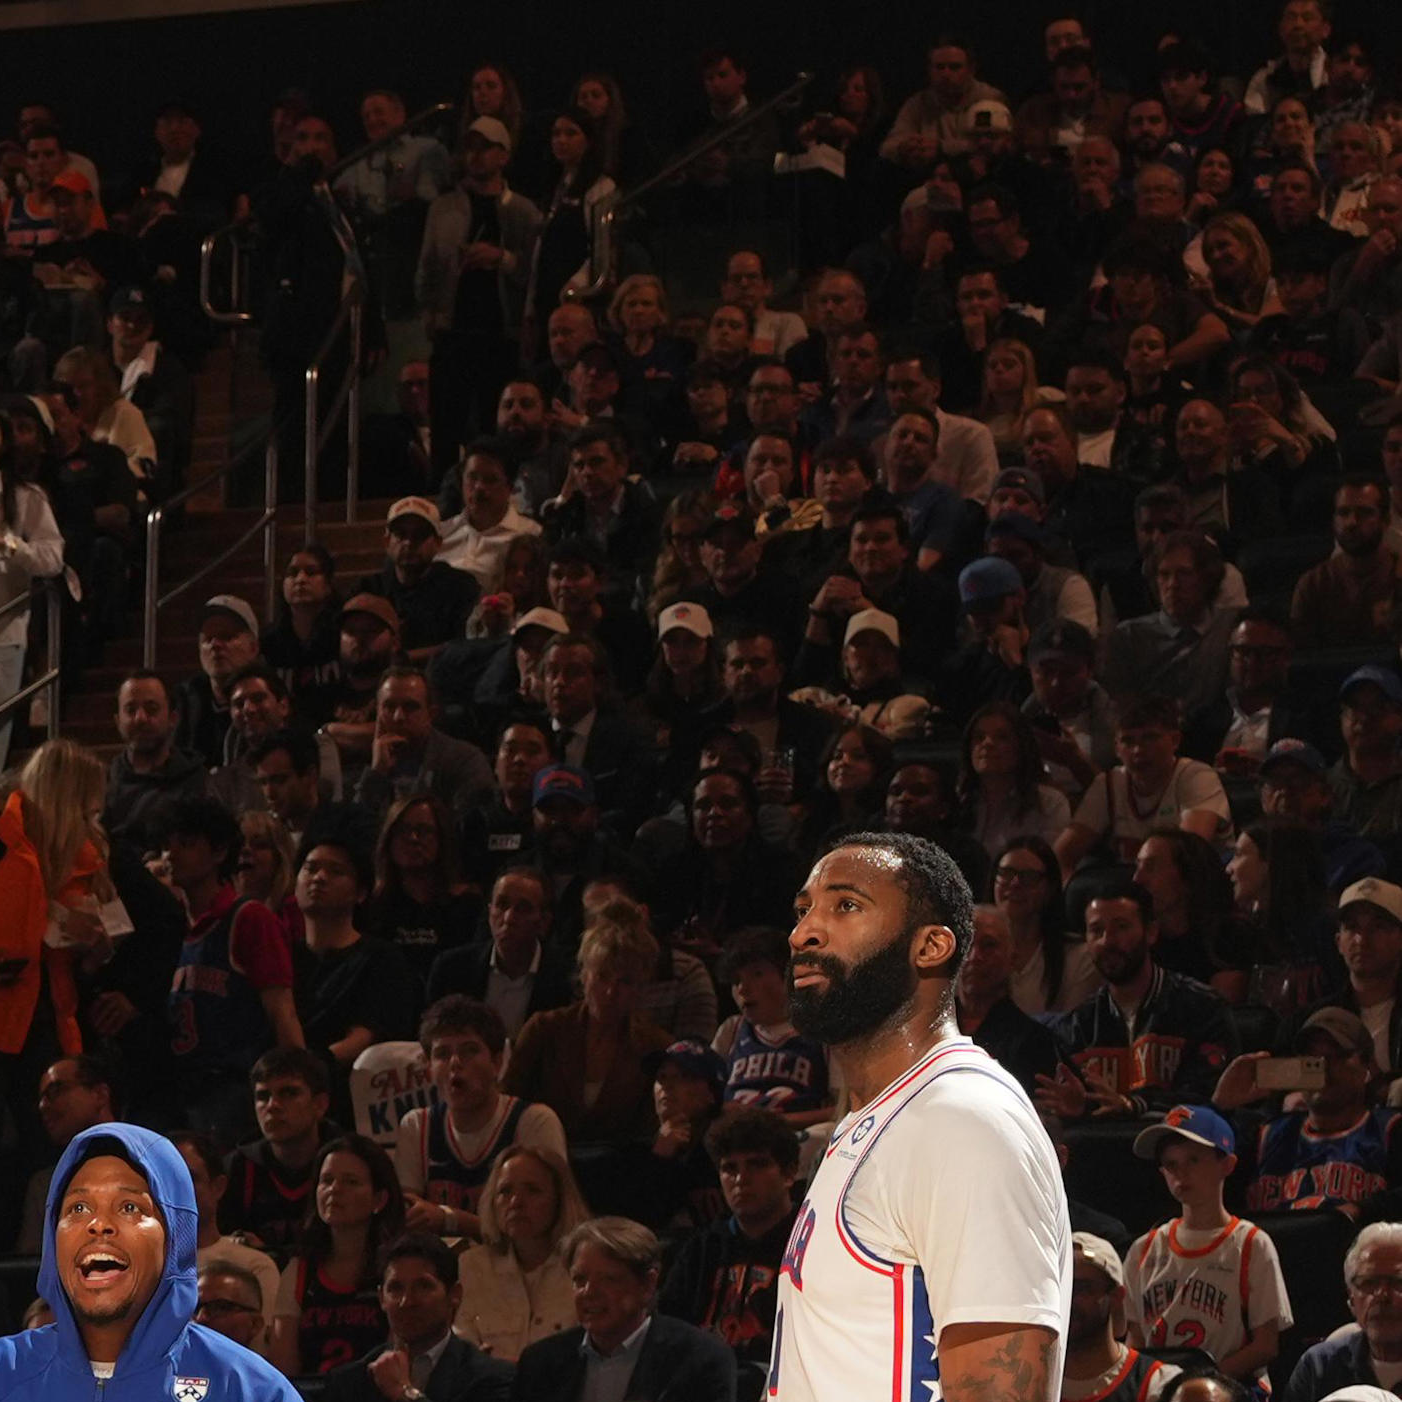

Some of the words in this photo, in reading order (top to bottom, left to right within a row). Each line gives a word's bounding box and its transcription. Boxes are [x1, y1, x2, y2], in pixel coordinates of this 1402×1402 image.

[729, 1051, 812, 1088] PHILA
[1248, 1167, 1306, 1211] NEW
[1310, 1160, 1387, 1204] YORK
[1142, 1259, 1178, 1322] NEW
[1180, 1257, 1228, 1323] YORK
